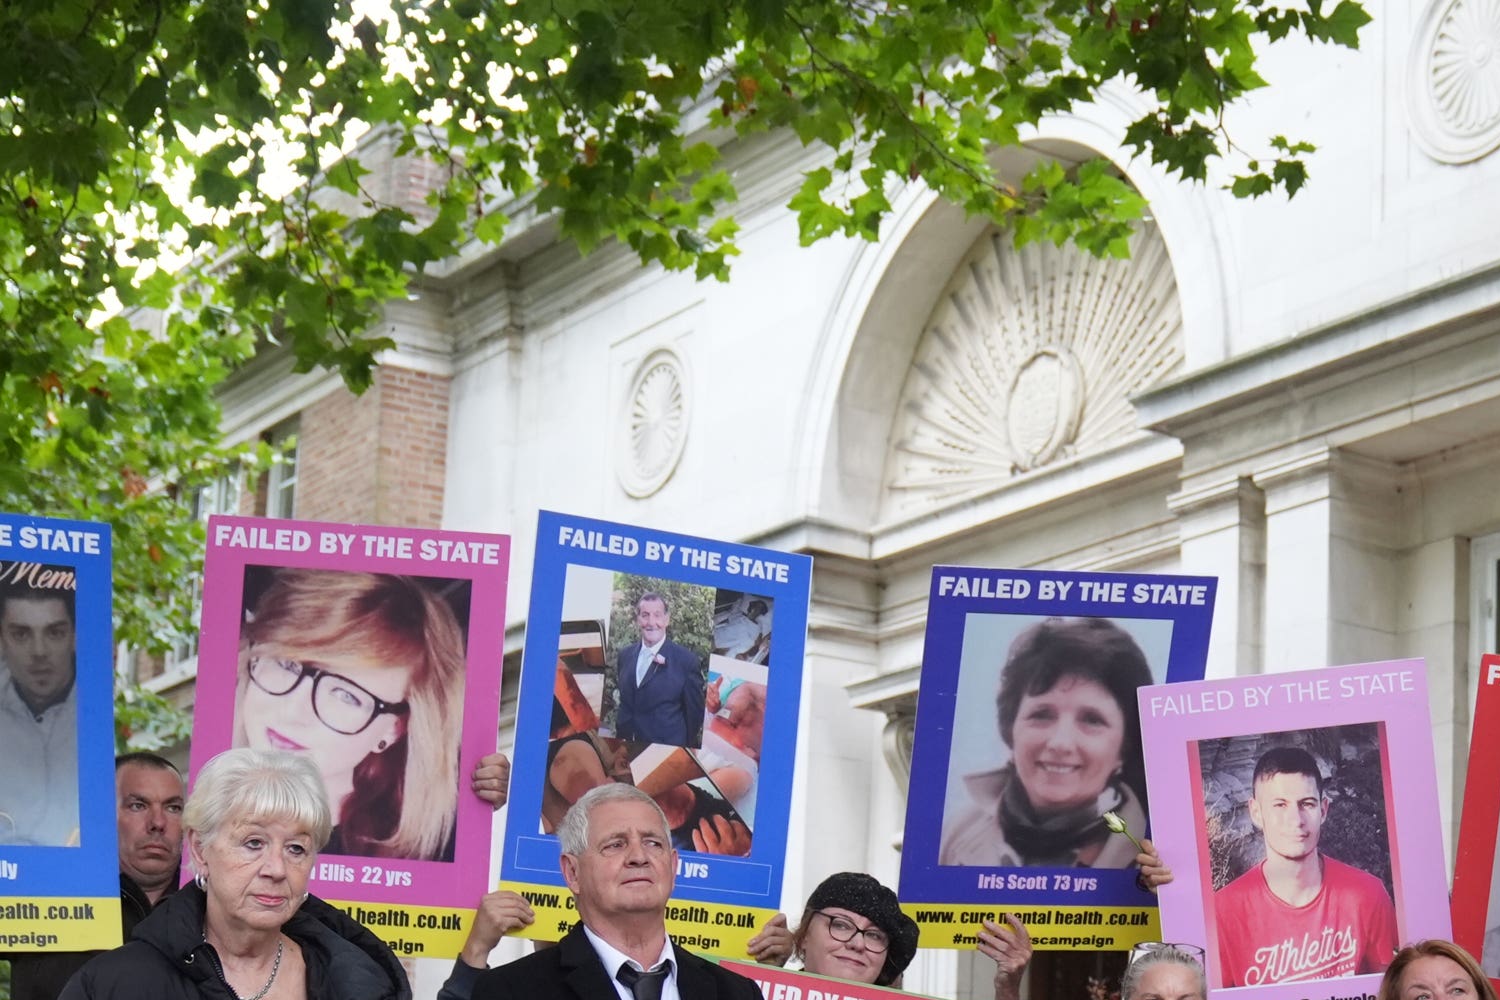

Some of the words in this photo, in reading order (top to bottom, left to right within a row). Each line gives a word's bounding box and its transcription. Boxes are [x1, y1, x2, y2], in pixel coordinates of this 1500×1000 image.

[19, 527, 100, 554] STATE
[216, 525, 311, 551] FAILED
[320, 533, 355, 554] BY
[363, 536, 413, 559] THE
[420, 540, 499, 564] STATE
[559, 527, 638, 556] FAILED
[645, 541, 675, 562] BY
[680, 547, 721, 571] THE
[726, 556, 789, 583] STATE
[939, 576, 1030, 599] FAILED
[1038, 581, 1073, 600] BY
[1079, 582, 1127, 602] THE
[1132, 584, 1207, 605] STATE
[320, 864, 354, 882] Ellis
[361, 866, 382, 884] 22
[386, 871, 411, 886] yrs
[978, 874, 1004, 889] Iris
[1008, 874, 1047, 889] Scott
[1054, 875, 1070, 890] 73
[1074, 878, 1097, 891] yrs
[1245, 925, 1357, 987] Athletics
